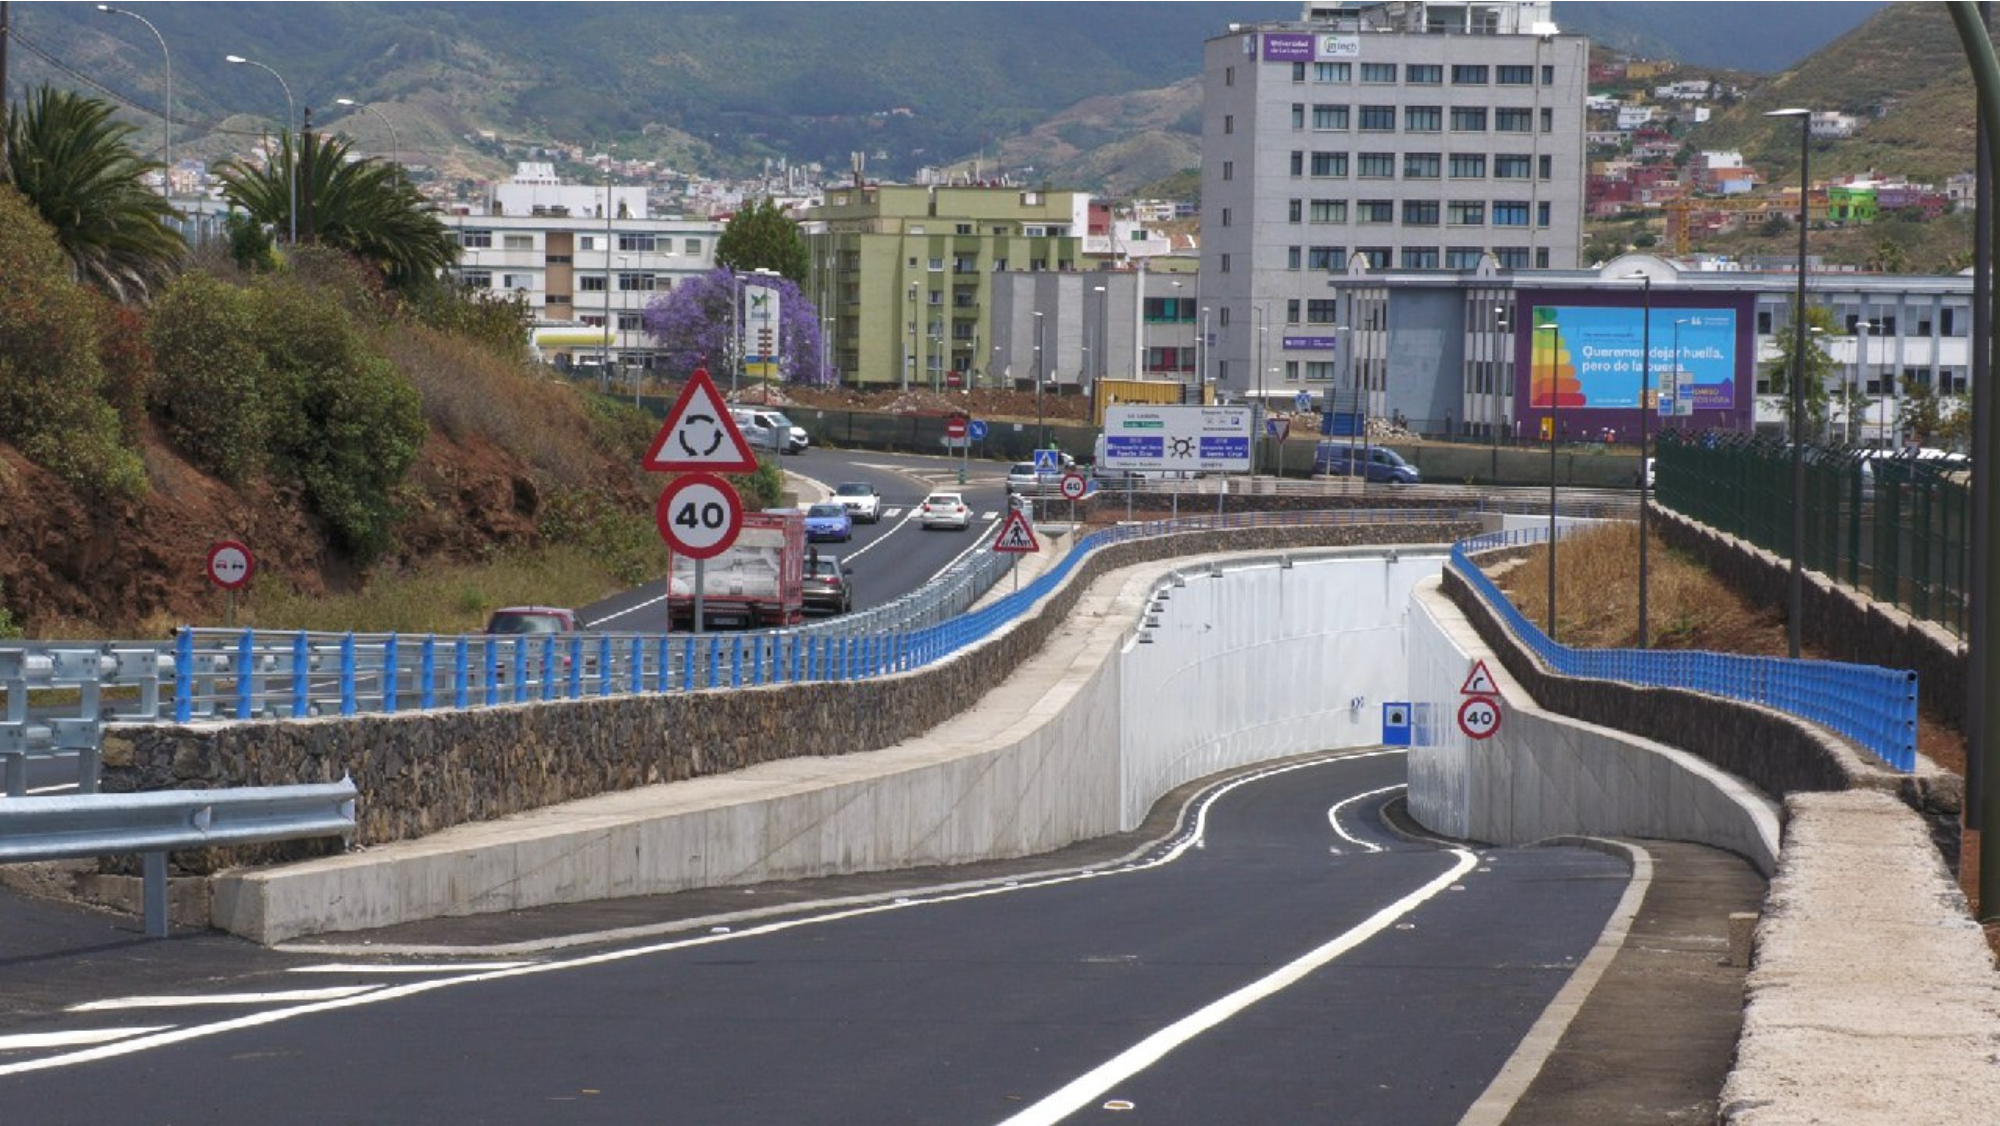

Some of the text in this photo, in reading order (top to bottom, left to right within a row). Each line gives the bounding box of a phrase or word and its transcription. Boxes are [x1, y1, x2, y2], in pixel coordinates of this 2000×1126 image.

[1649, 347, 1679, 361] dejar
[1684, 347, 1724, 360] huella,
[1582, 362, 1611, 374] pero
[1613, 360, 1629, 371] de
[1632, 360, 1643, 371] la
[1066, 481, 1080, 490] 40
[675, 502, 724, 529] 40
[1467, 711, 1492, 725] 40
